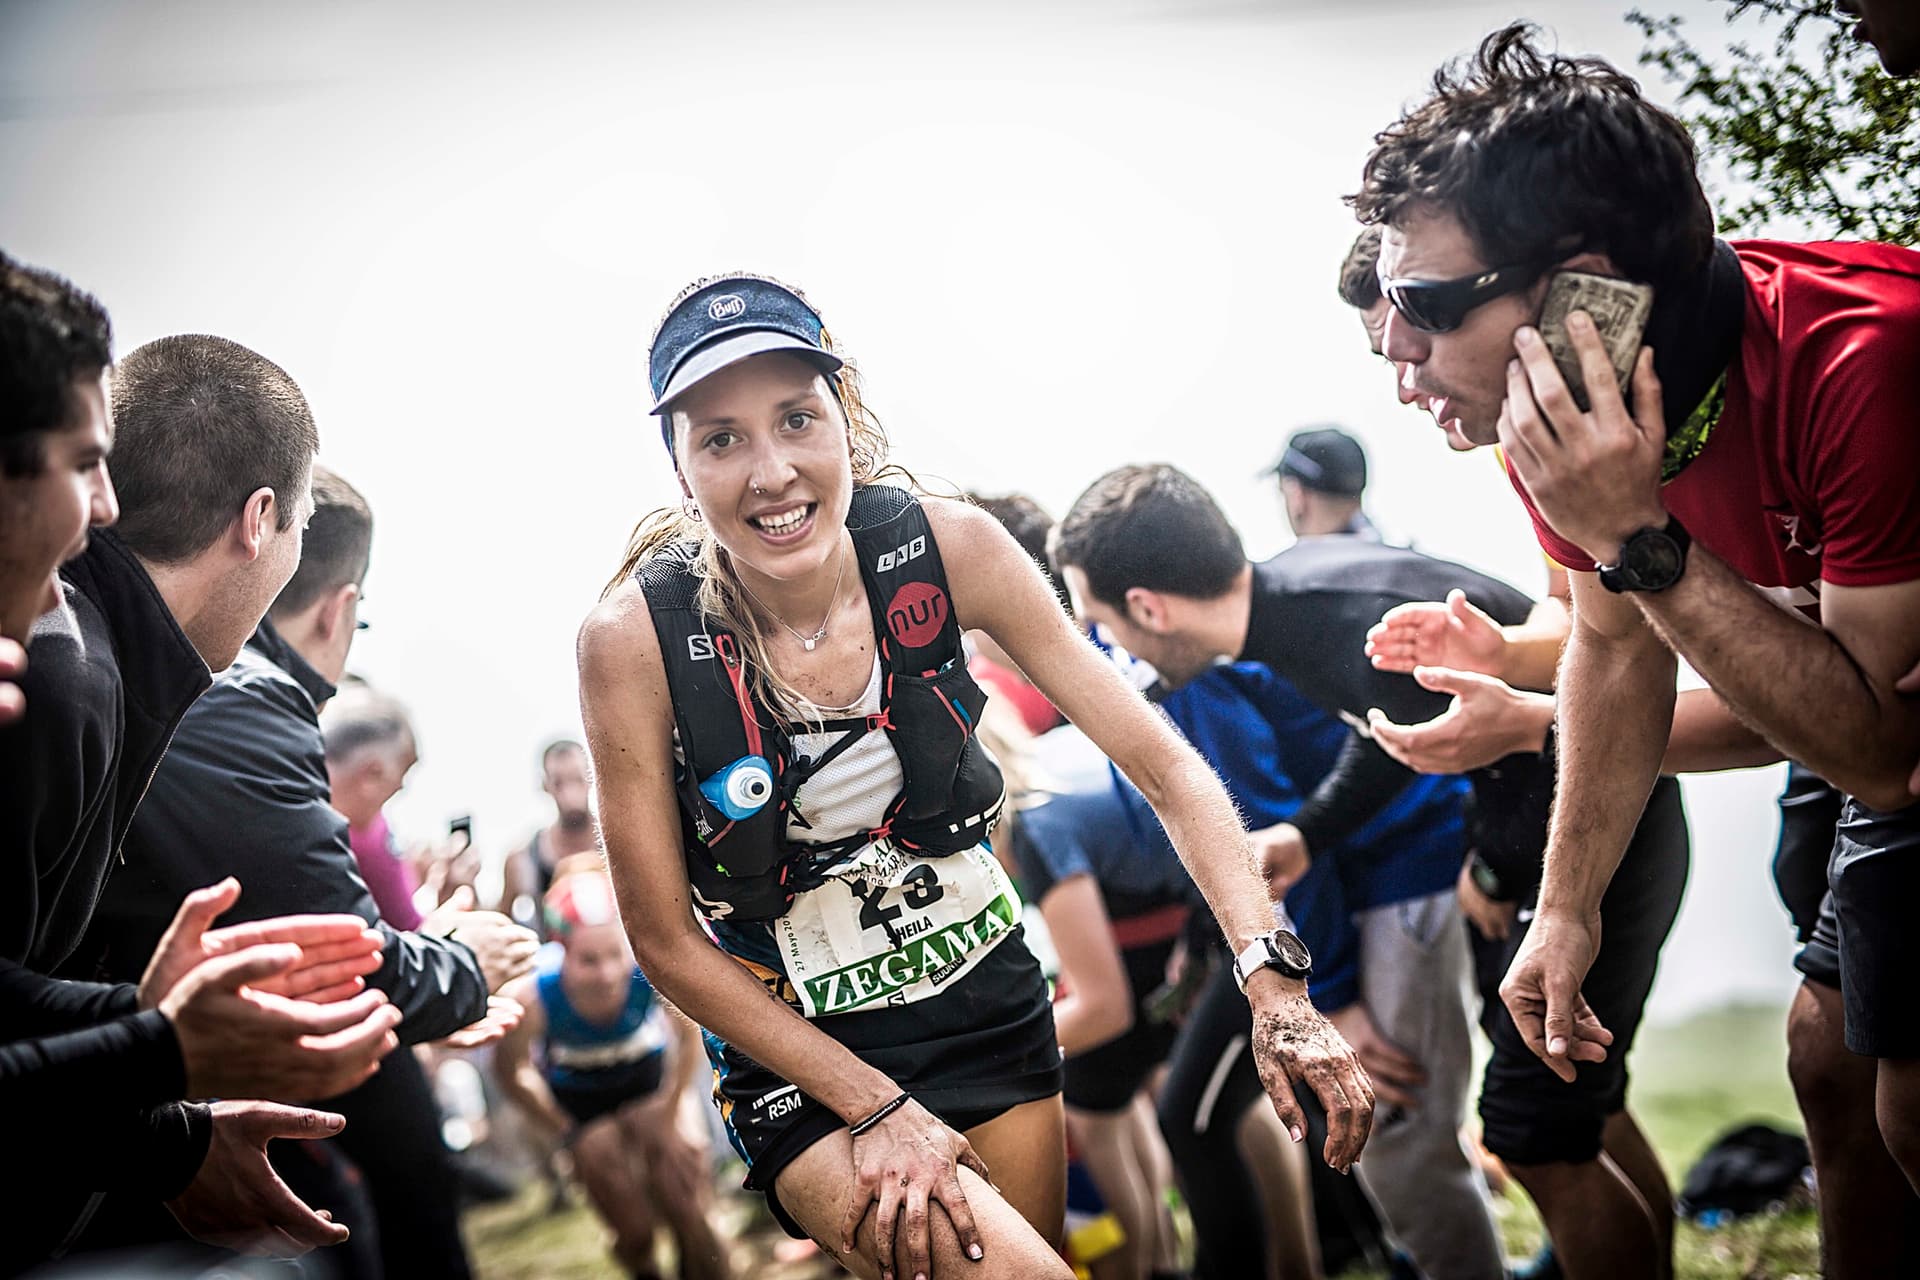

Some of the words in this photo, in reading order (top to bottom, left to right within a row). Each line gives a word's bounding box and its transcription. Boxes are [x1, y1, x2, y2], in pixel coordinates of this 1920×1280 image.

[712, 299, 741, 318] Buff
[882, 540, 922, 568] LAB
[890, 593, 941, 636] nur
[782, 915, 792, 932] 201
[888, 915, 934, 943] HEILA
[788, 932, 801, 957] Mayo
[794, 960, 805, 975] 27
[815, 907, 1014, 1013] ZEGAMA
[768, 1092, 802, 1121] RSM
